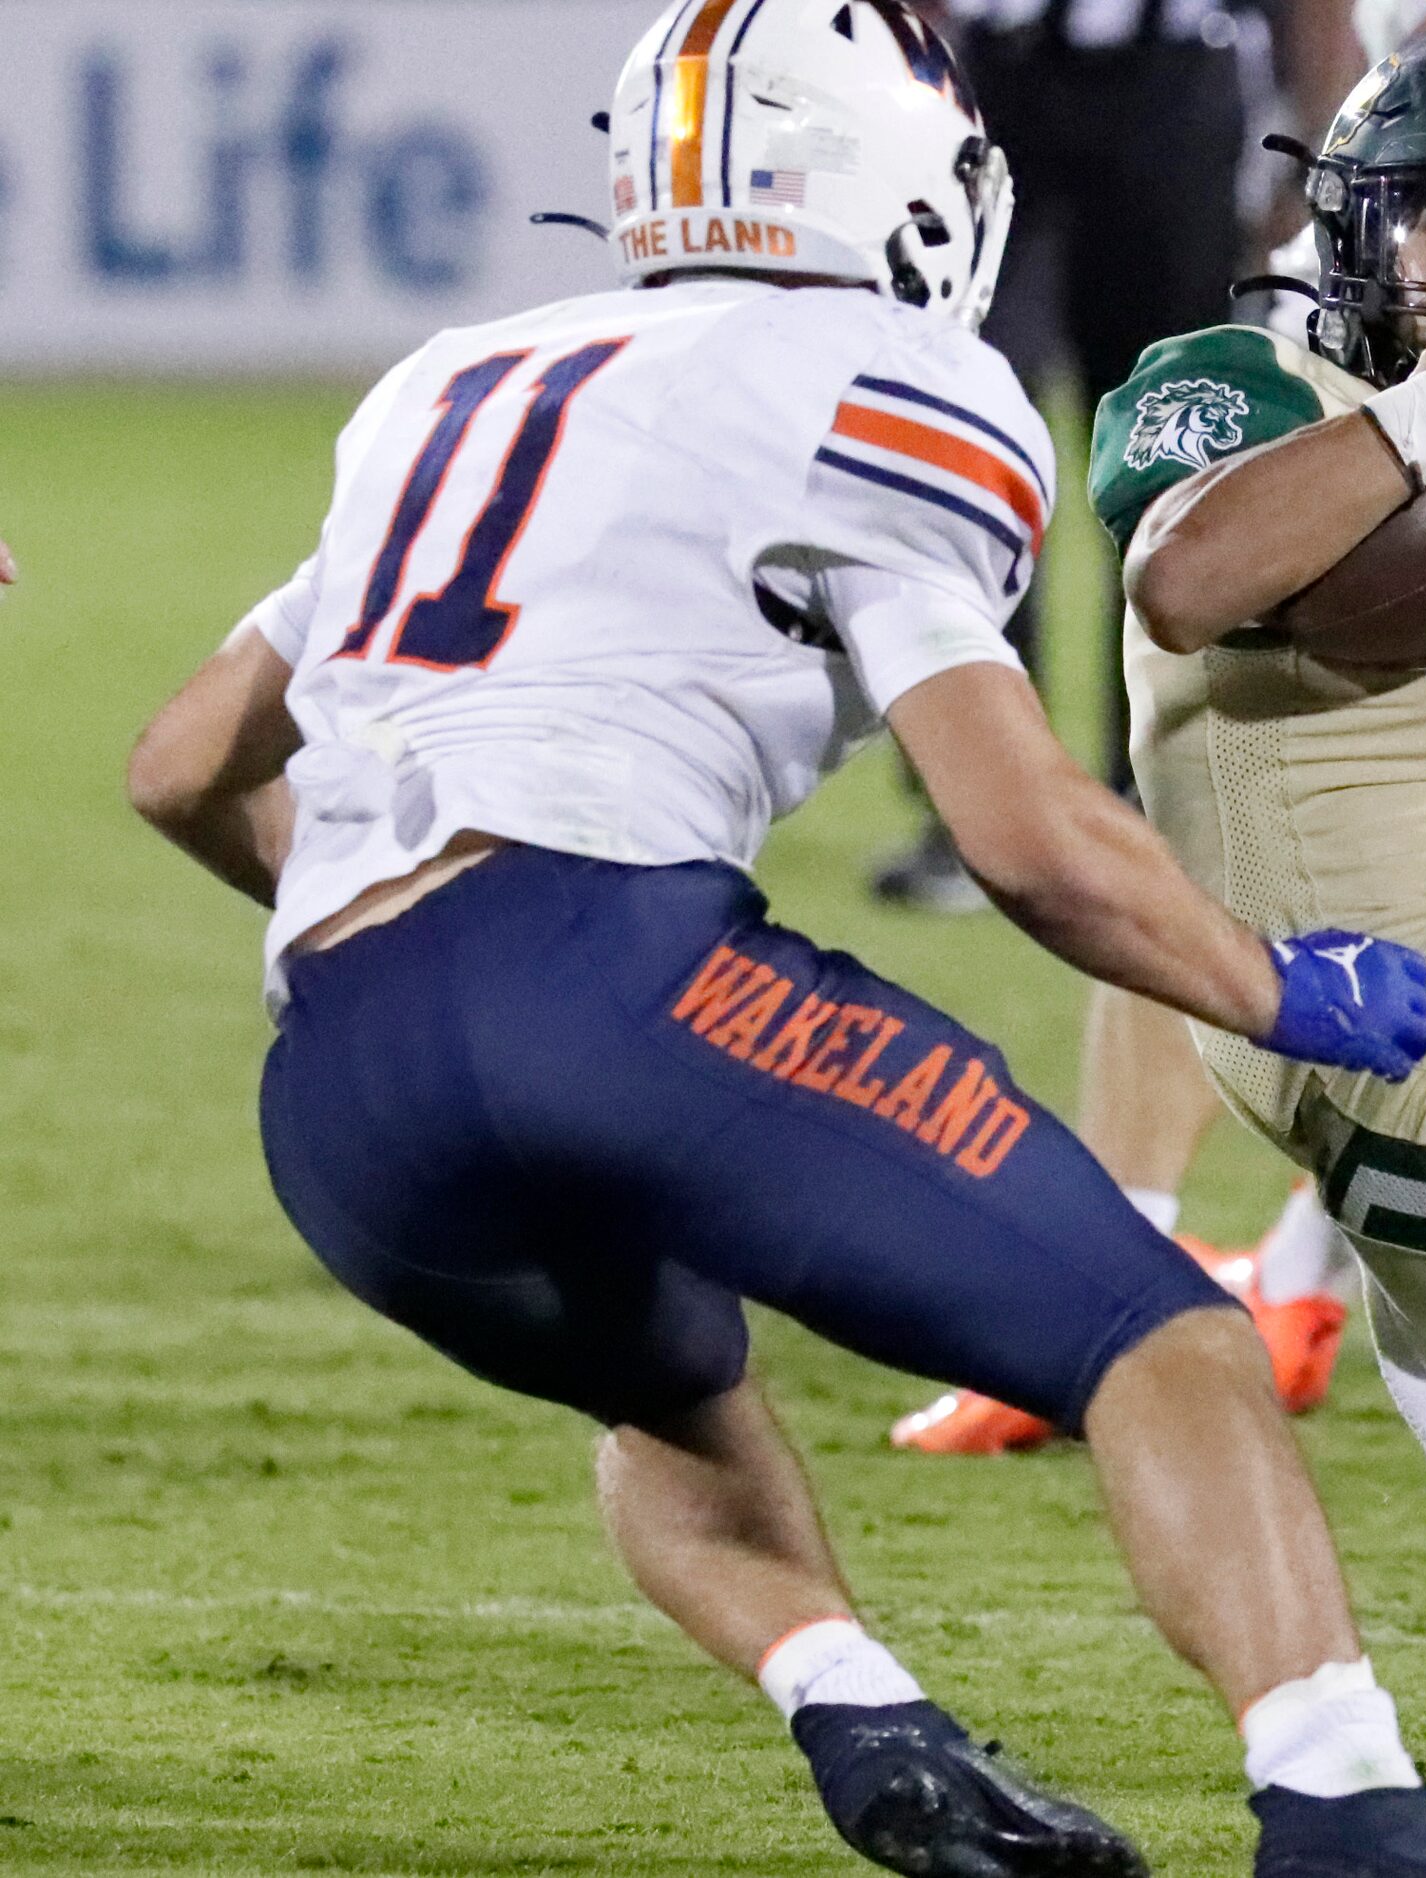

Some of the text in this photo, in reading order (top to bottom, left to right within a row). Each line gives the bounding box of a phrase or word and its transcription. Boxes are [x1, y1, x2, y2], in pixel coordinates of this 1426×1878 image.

[76, 36, 494, 294] Life
[618, 216, 797, 264] THE LAND
[318, 335, 635, 673] 11
[671, 945, 1031, 1178] WAKELAND
